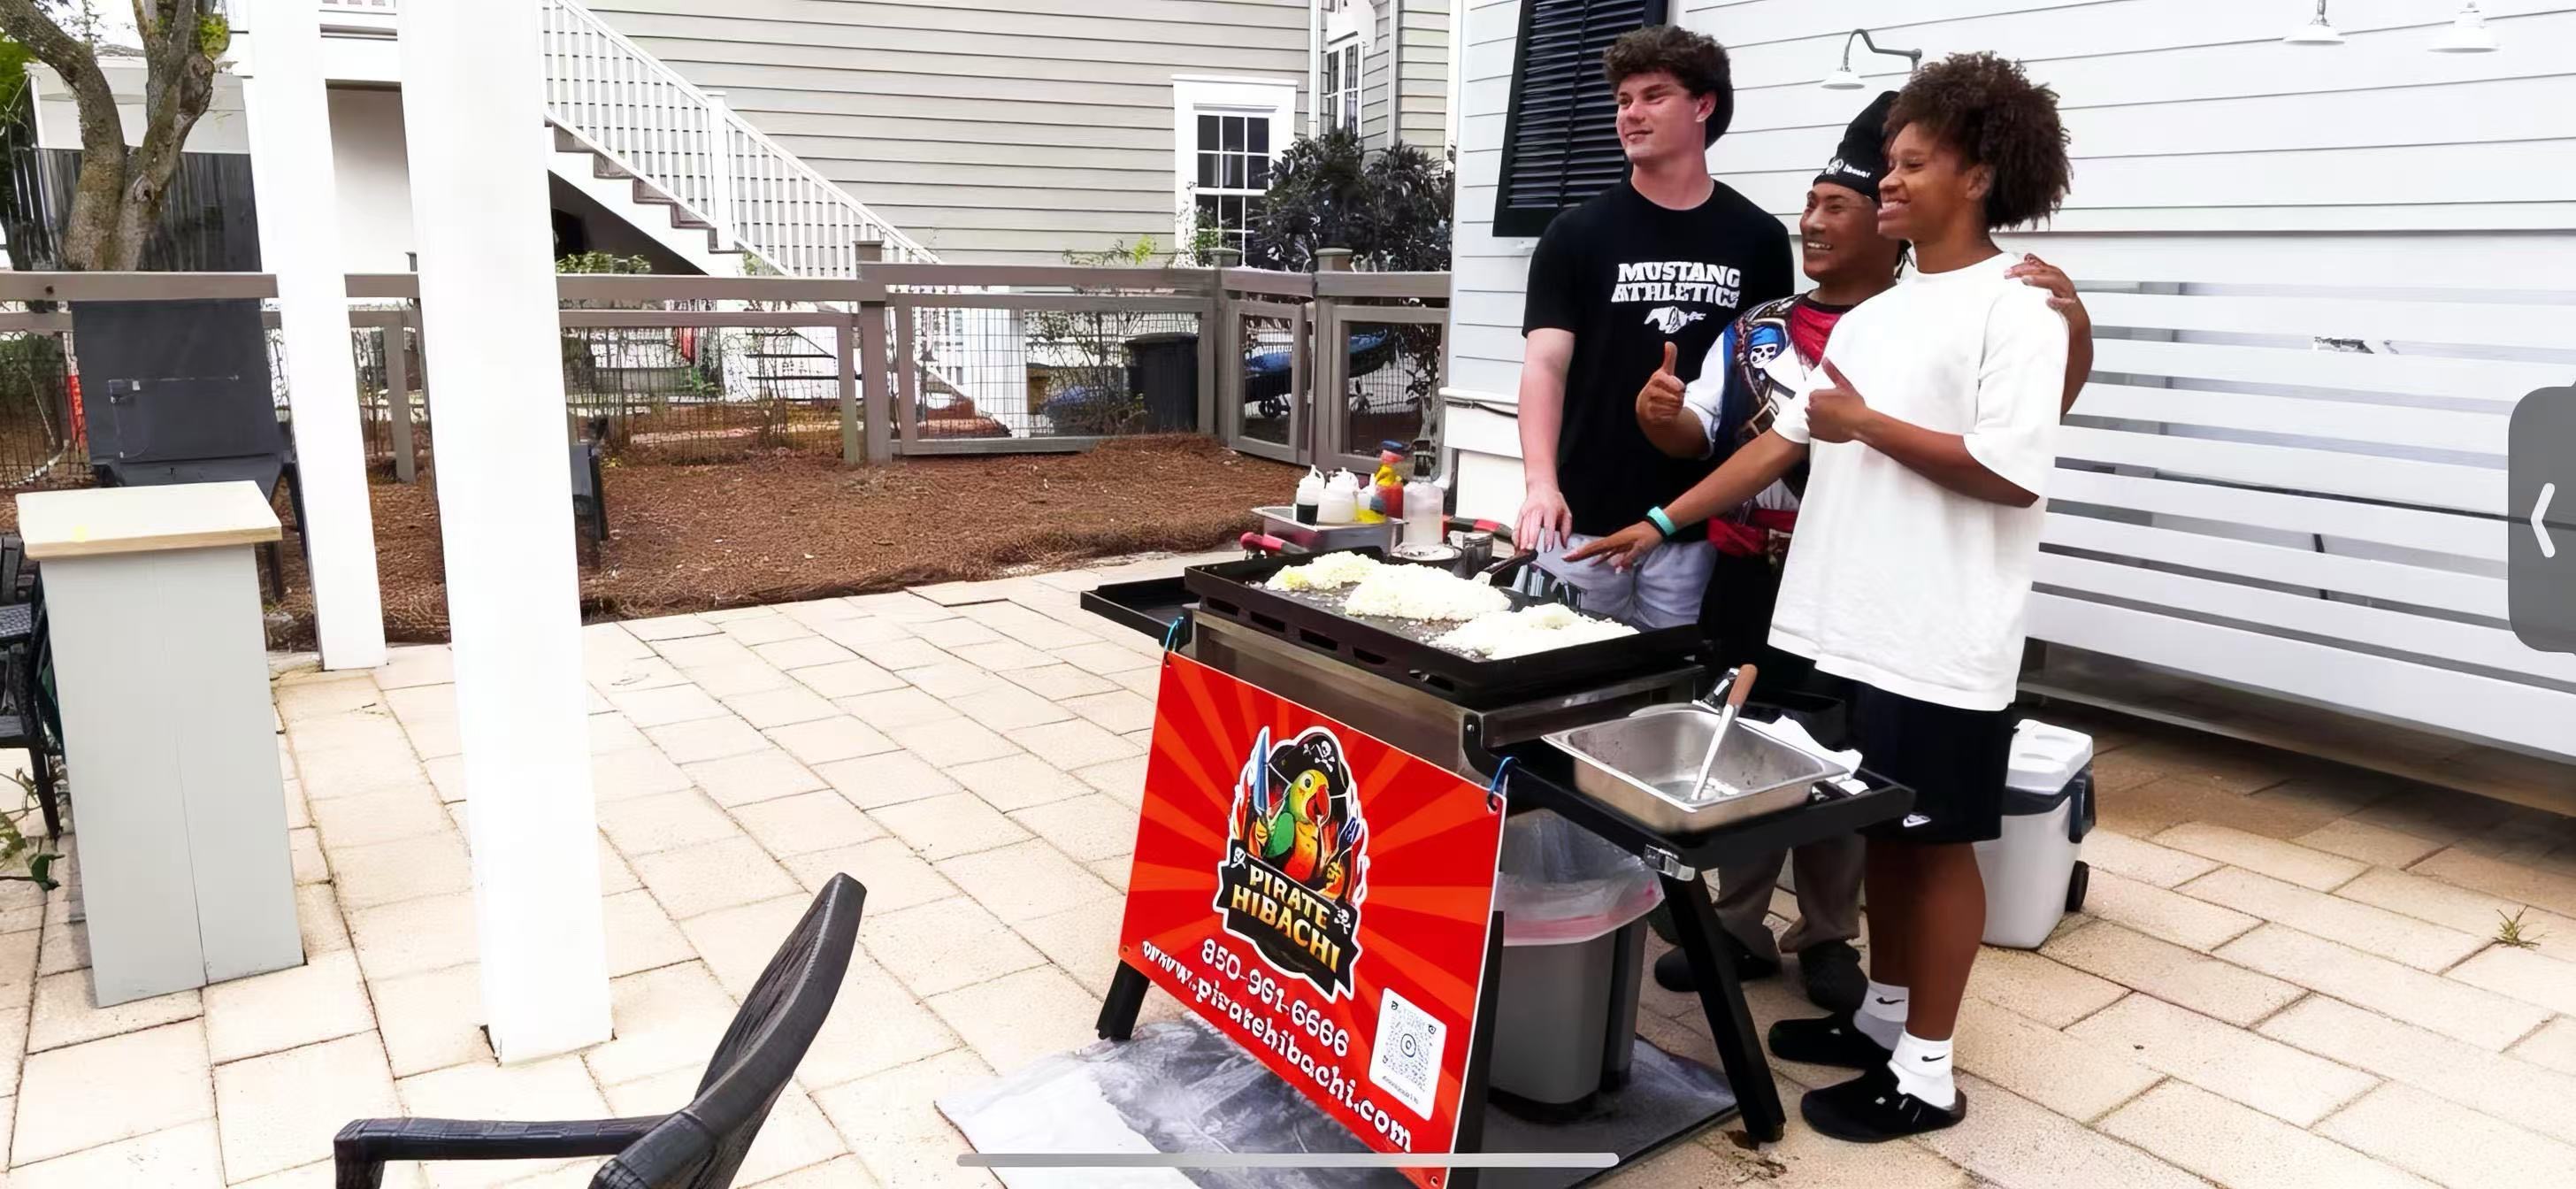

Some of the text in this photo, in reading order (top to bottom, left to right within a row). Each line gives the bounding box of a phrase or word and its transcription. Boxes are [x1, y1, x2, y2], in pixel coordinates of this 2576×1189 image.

[1611, 281, 1741, 310] ATHLETICS
[1617, 261, 1741, 288] MUSTANG
[1230, 883, 1341, 973] HIBACHI
[1249, 864, 1330, 930] PIRATE
[1201, 938, 1350, 1057] 850-961-6666
